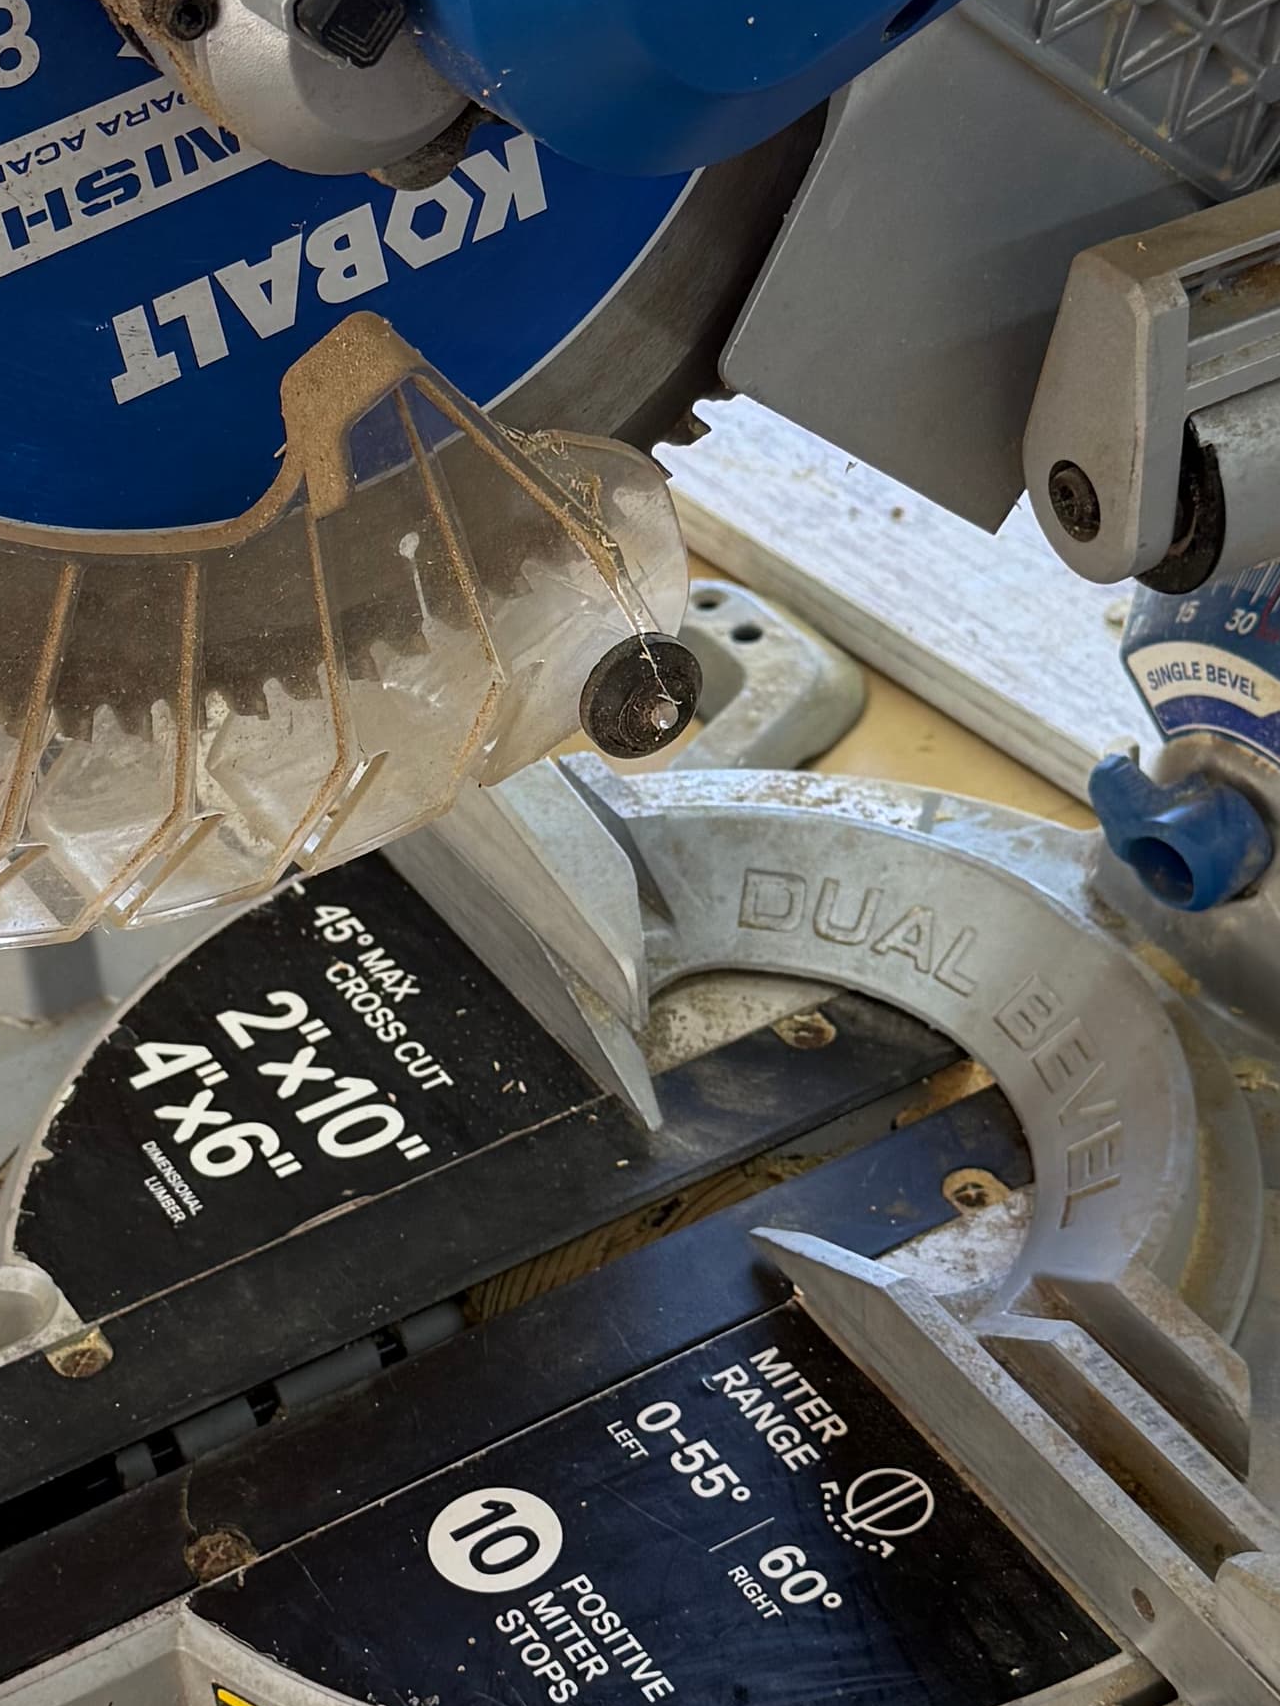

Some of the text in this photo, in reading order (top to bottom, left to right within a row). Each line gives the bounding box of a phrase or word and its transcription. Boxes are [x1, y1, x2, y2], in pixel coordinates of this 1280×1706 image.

[98, 85, 189, 137] ARA
[109, 133, 549, 404] KOBALT
[1175, 601, 1201, 624] 15
[1224, 608, 1258, 636] 30
[1146, 661, 1263, 703] SINGLE BEVEL
[358, 948, 420, 1003] MAX
[325, 962, 454, 1091] CROSS CUT
[737, 867, 1122, 1231] DUAL BEVEL
[141, 1140, 204, 1217] DIMENSIONAL
[143, 1175, 187, 1225] LUMBER
[711, 1364, 821, 1472] RANGE
[749, 1346, 848, 1444] MITER
[606, 1420, 650, 1460] LEFT
[449, 1499, 541, 1575] 10
[727, 1565, 783, 1620] RIGHT
[758, 1544, 844, 1609] 60°
[495, 1608, 579, 1704] STOPS
[527, 1591, 610, 1683] MITER
[561, 1573, 676, 1704] POSITIVE
